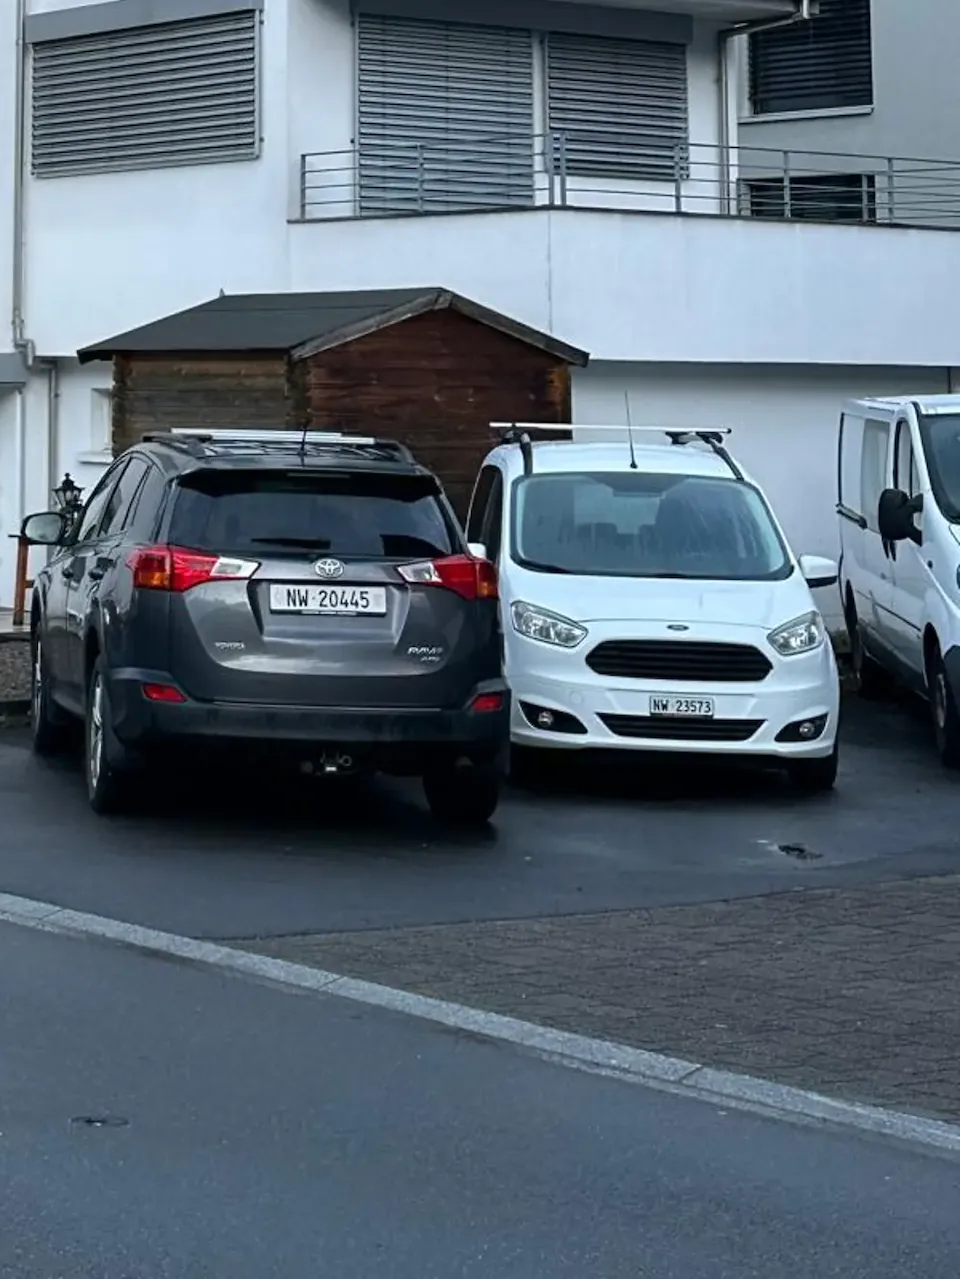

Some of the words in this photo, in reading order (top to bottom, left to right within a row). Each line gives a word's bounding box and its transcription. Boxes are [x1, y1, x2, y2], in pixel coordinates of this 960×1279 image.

[286, 588, 308, 607] NW
[319, 590, 370, 608] 20445
[653, 699, 669, 711] NW
[676, 699, 711, 713] 23573
